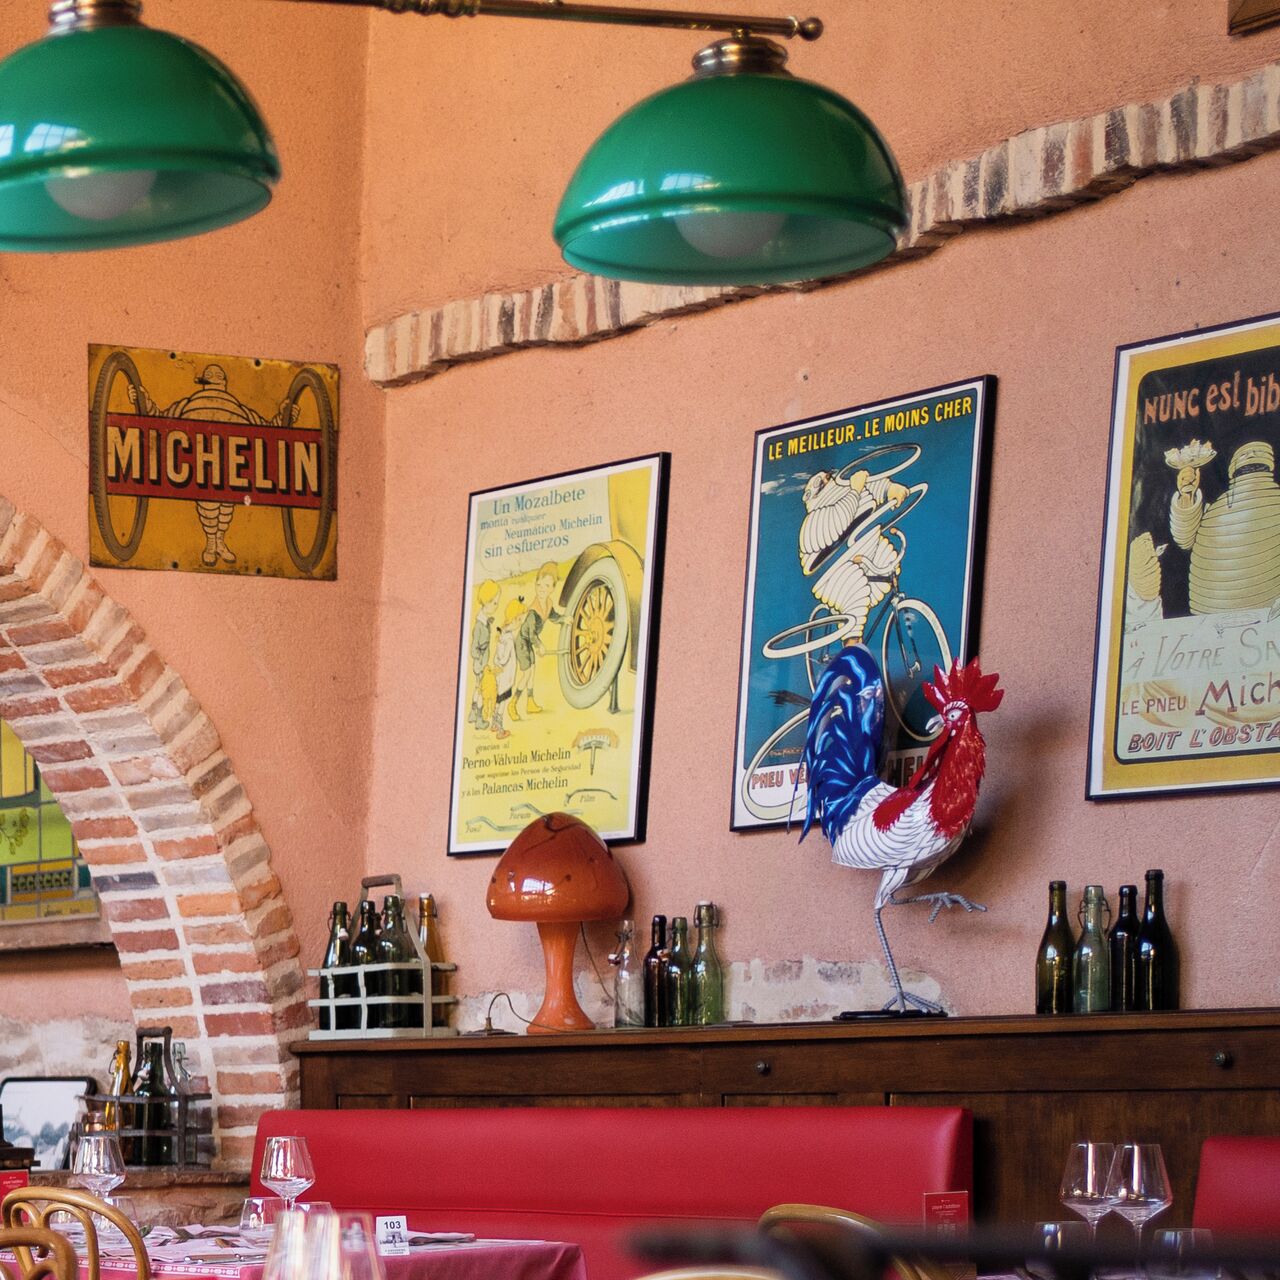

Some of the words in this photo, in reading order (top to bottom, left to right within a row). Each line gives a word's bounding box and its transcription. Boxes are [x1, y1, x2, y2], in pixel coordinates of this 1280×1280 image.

[1143, 387, 1200, 425] NUNC
[768, 442, 783, 461] LE
[864, 418, 880, 438] LE
[884, 406, 929, 433] MOINS
[934, 396, 973, 422] CHER
[106, 426, 321, 496] MICHELIN
[493, 499, 511, 516] Un
[515, 488, 586, 512] Mozalbete
[480, 516, 509, 531] monta
[559, 514, 603, 531] Michelin
[484, 545, 503, 559] sin
[506, 534, 569, 555] esfuerzos
[1121, 700, 1139, 716] LE
[1146, 695, 1187, 714] PNEU
[1128, 730, 1183, 753] BOIT
[531, 747, 571, 761] Michelin
[482, 782, 524, 795] Palancas
[526, 777, 568, 791] Michelin
[751, 769, 784, 790] PNEU
[384, 1220, 402, 1230] 103
